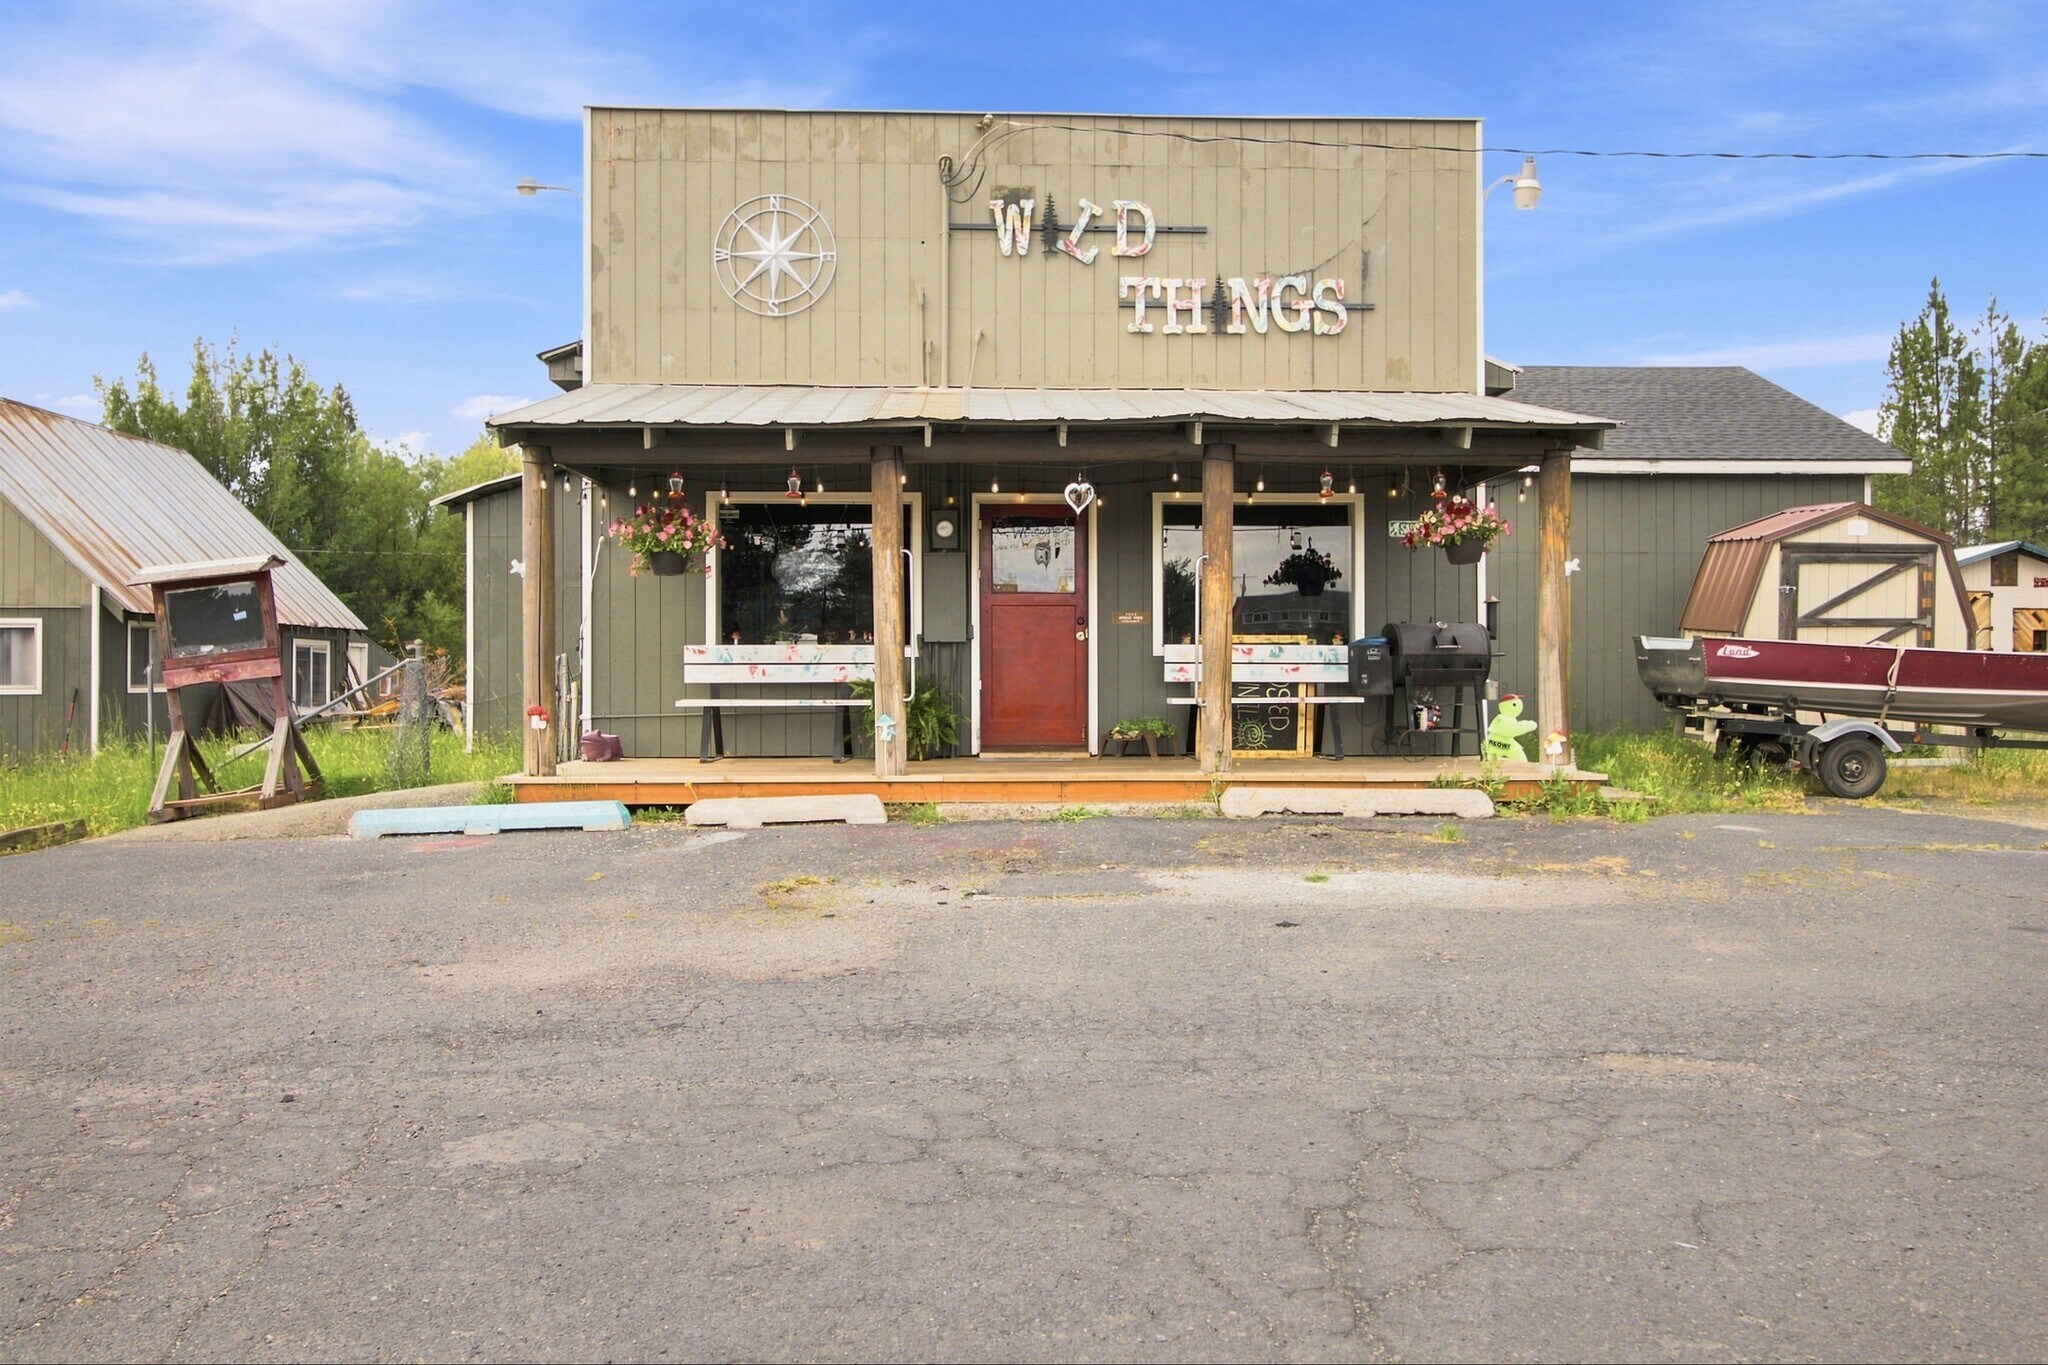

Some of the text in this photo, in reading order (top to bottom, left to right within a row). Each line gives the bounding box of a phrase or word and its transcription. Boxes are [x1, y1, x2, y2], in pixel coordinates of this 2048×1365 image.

[769, 194, 780, 211] N
[714, 247, 730, 261] W
[767, 300, 779, 315] S
